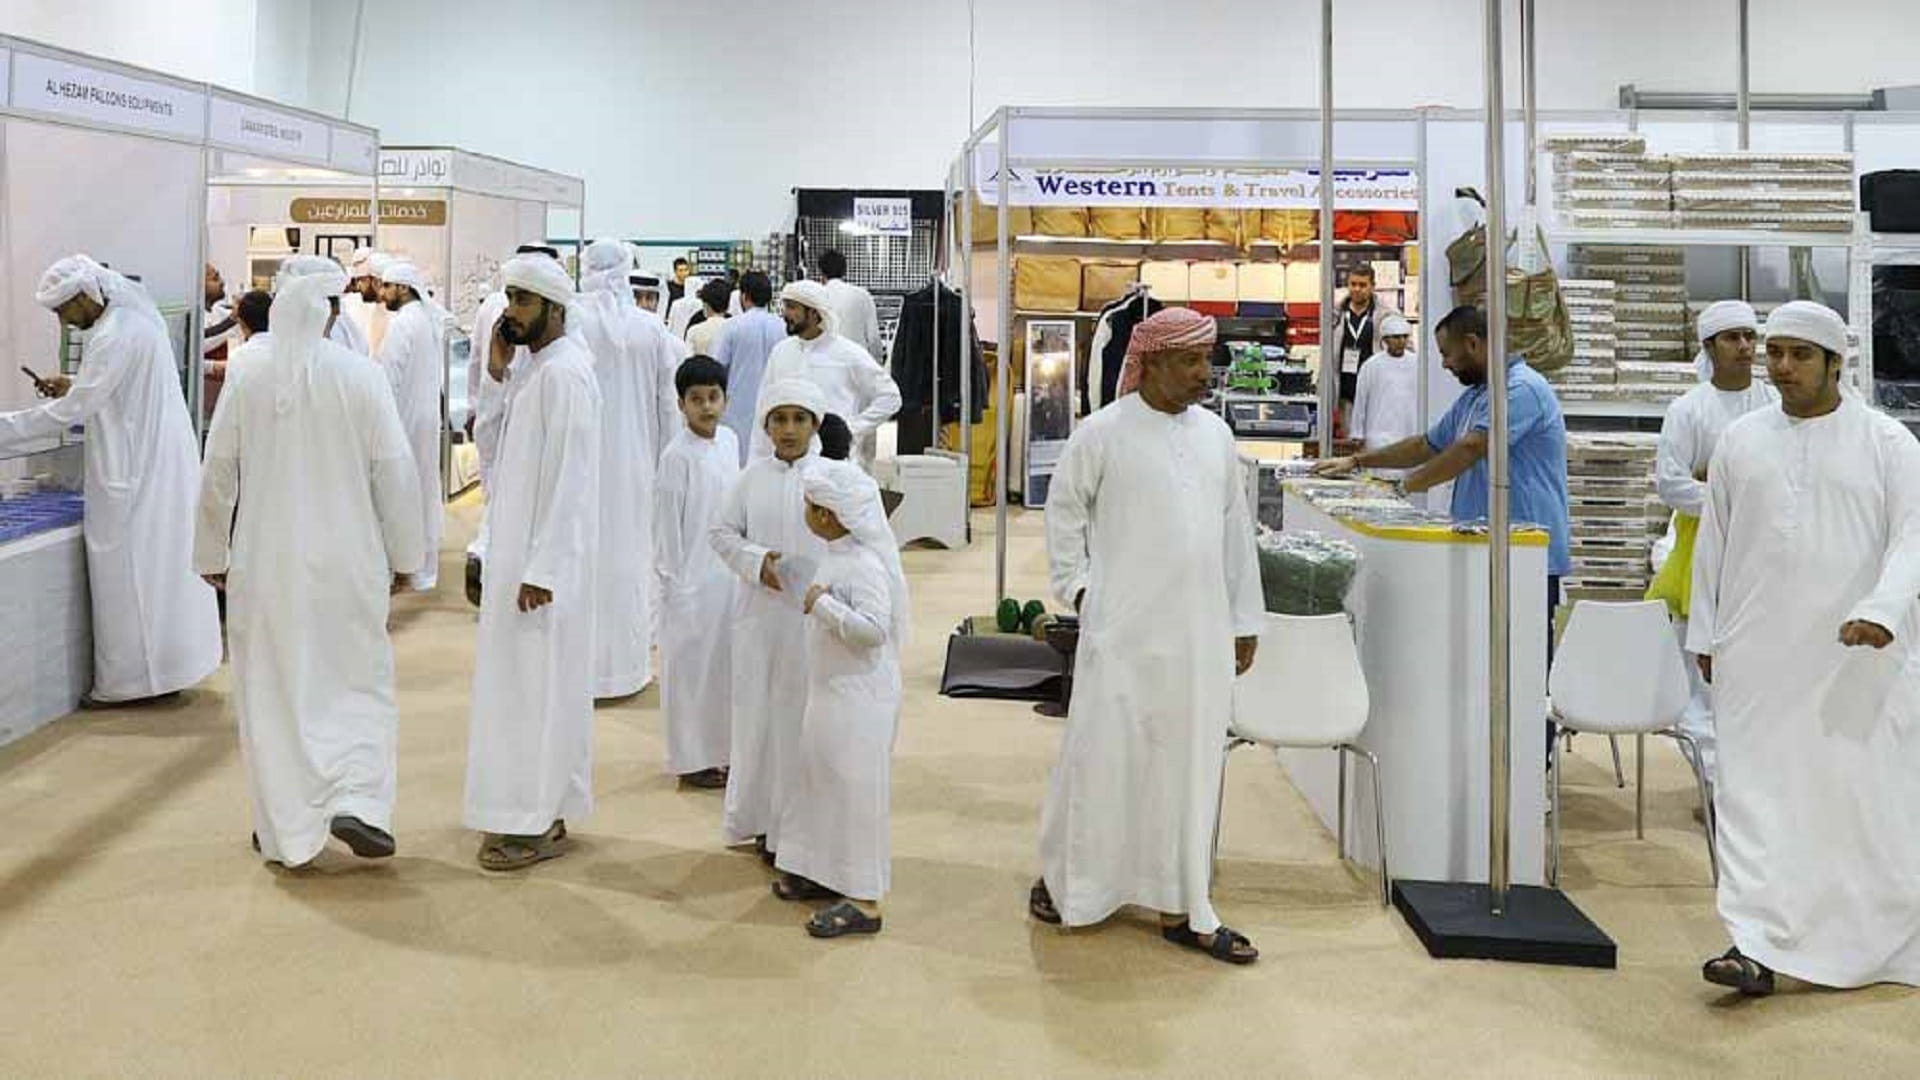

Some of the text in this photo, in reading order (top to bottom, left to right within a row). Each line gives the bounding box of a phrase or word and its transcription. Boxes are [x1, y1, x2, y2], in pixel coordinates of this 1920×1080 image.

[1035, 176, 1156, 195] Western
[1163, 181, 1215, 197] Tents
[1244, 183, 1305, 199] Travel
[1310, 184, 1419, 200] Acessories
